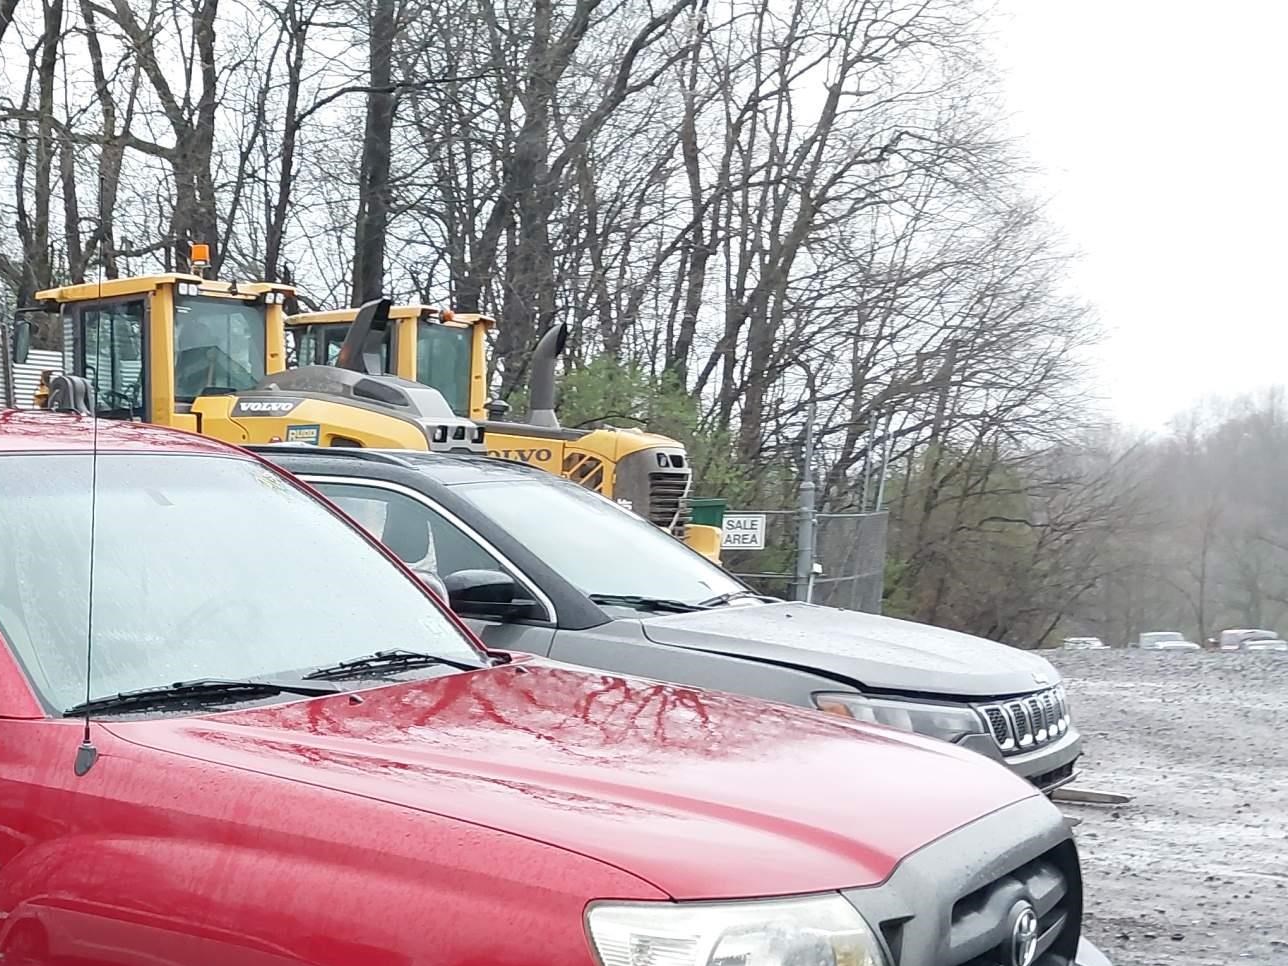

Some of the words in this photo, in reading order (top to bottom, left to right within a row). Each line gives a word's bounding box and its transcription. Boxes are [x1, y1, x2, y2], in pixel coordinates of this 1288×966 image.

[240, 402, 294, 412] VOLVO
[487, 449, 552, 462] OLVO
[725, 519, 759, 530] SALE
[724, 534, 759, 545] AREA
